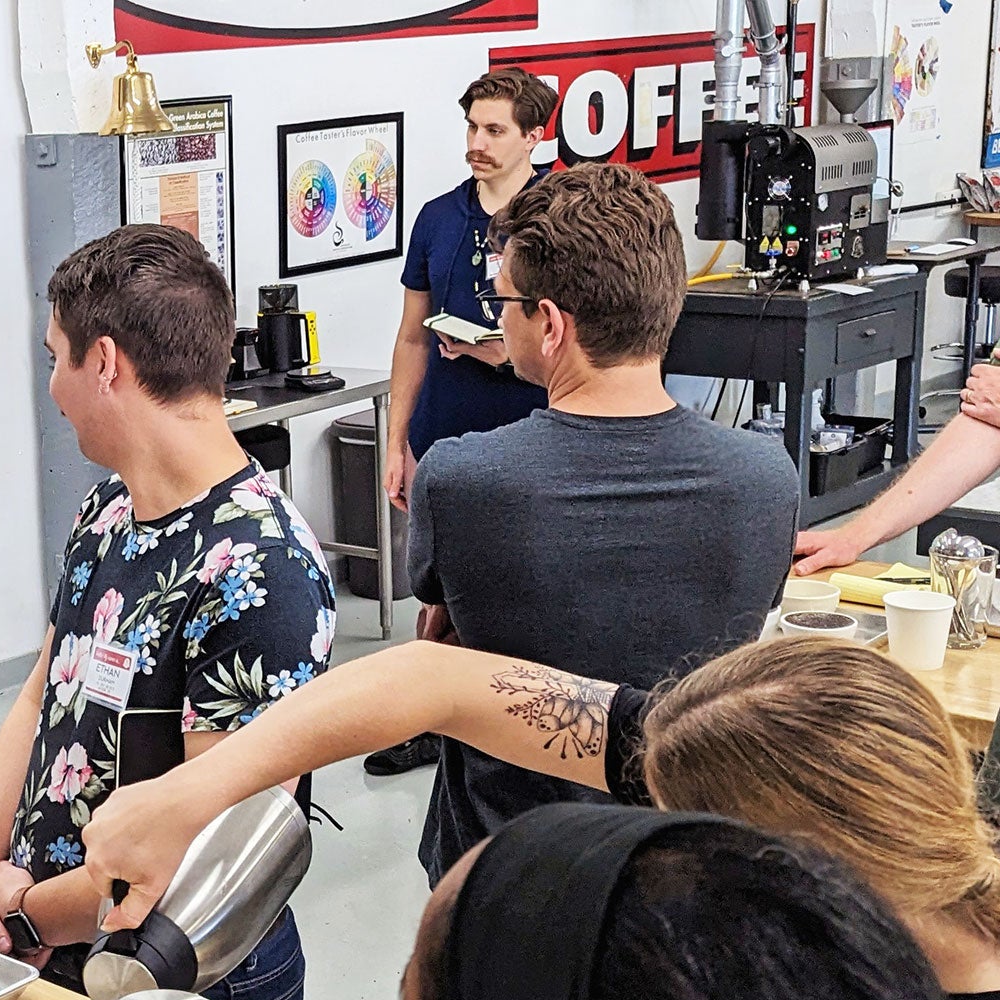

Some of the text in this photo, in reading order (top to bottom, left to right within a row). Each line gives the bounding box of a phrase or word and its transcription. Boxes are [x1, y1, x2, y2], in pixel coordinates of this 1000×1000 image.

[169, 108, 224, 122] Green Arabica Coffee
[173, 121, 205, 132] lassification
[295, 124, 389, 144] Coffee Taster's Flavor Wheel
[95, 663, 121, 678] ETHAN
